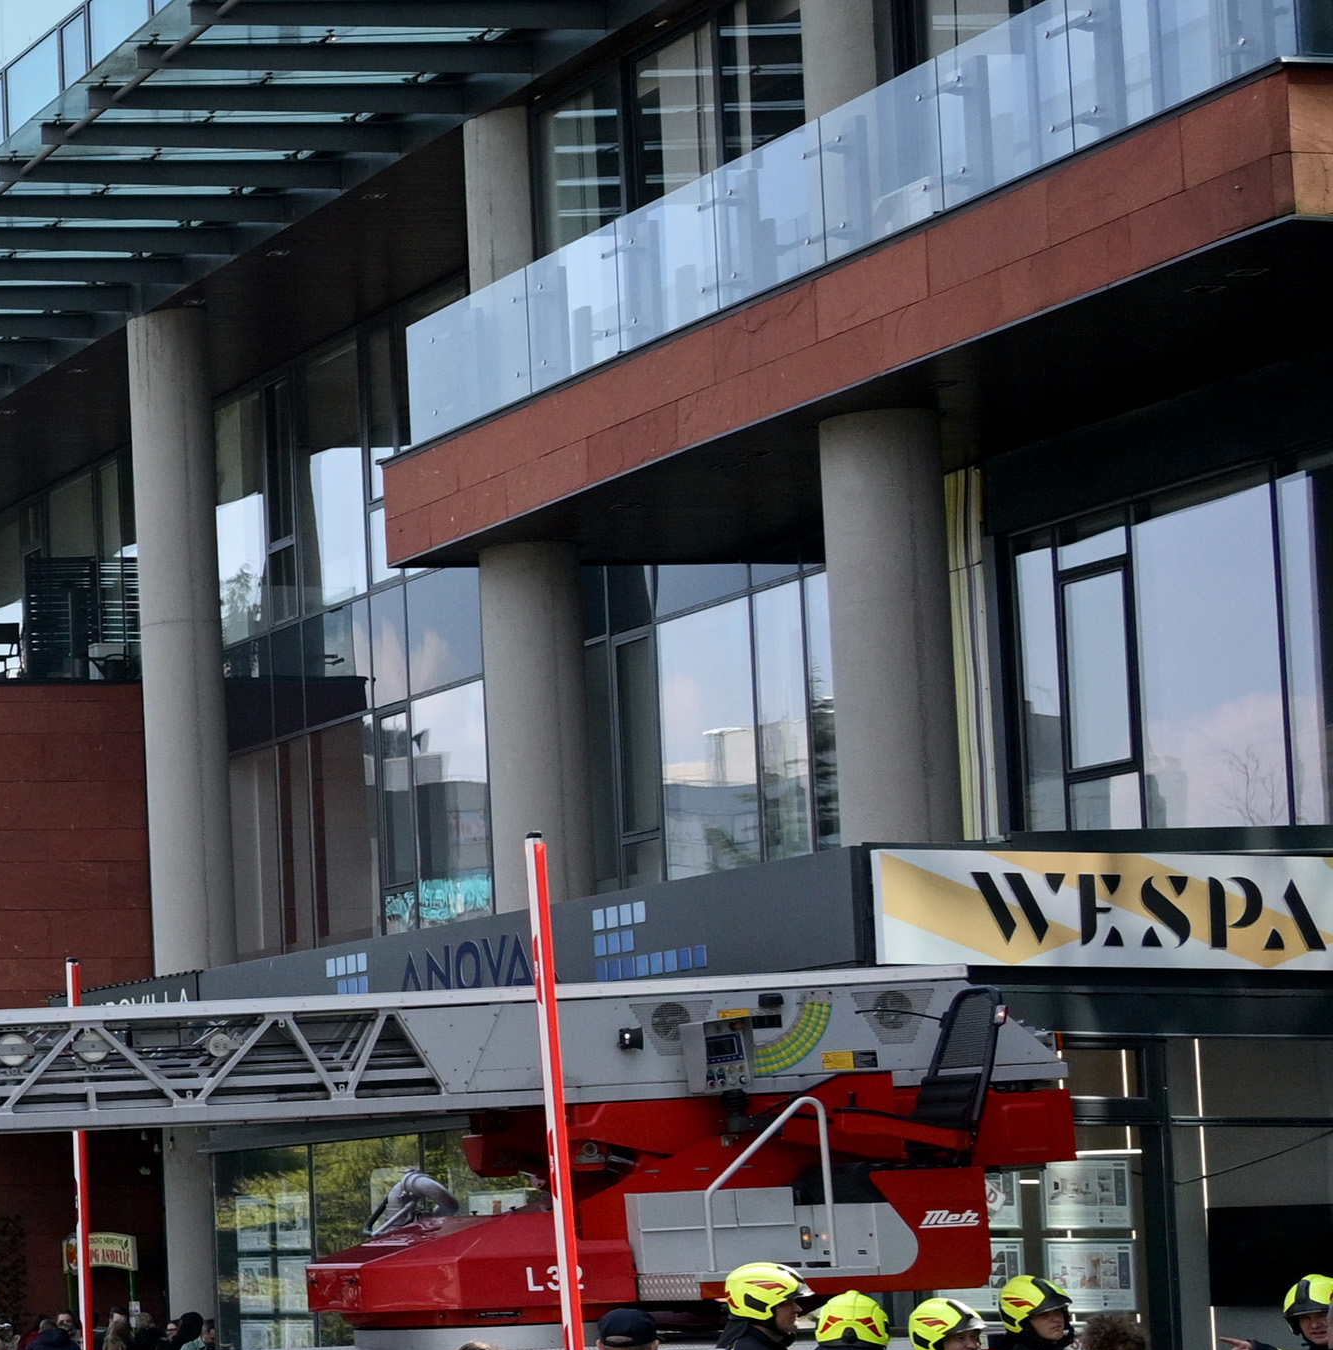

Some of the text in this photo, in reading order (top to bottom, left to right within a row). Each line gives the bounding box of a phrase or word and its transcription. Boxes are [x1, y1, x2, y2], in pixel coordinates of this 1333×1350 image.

[969, 871, 1327, 952] WESPA
[401, 932, 562, 992] ANOVA
[919, 1209, 980, 1229] Metz
